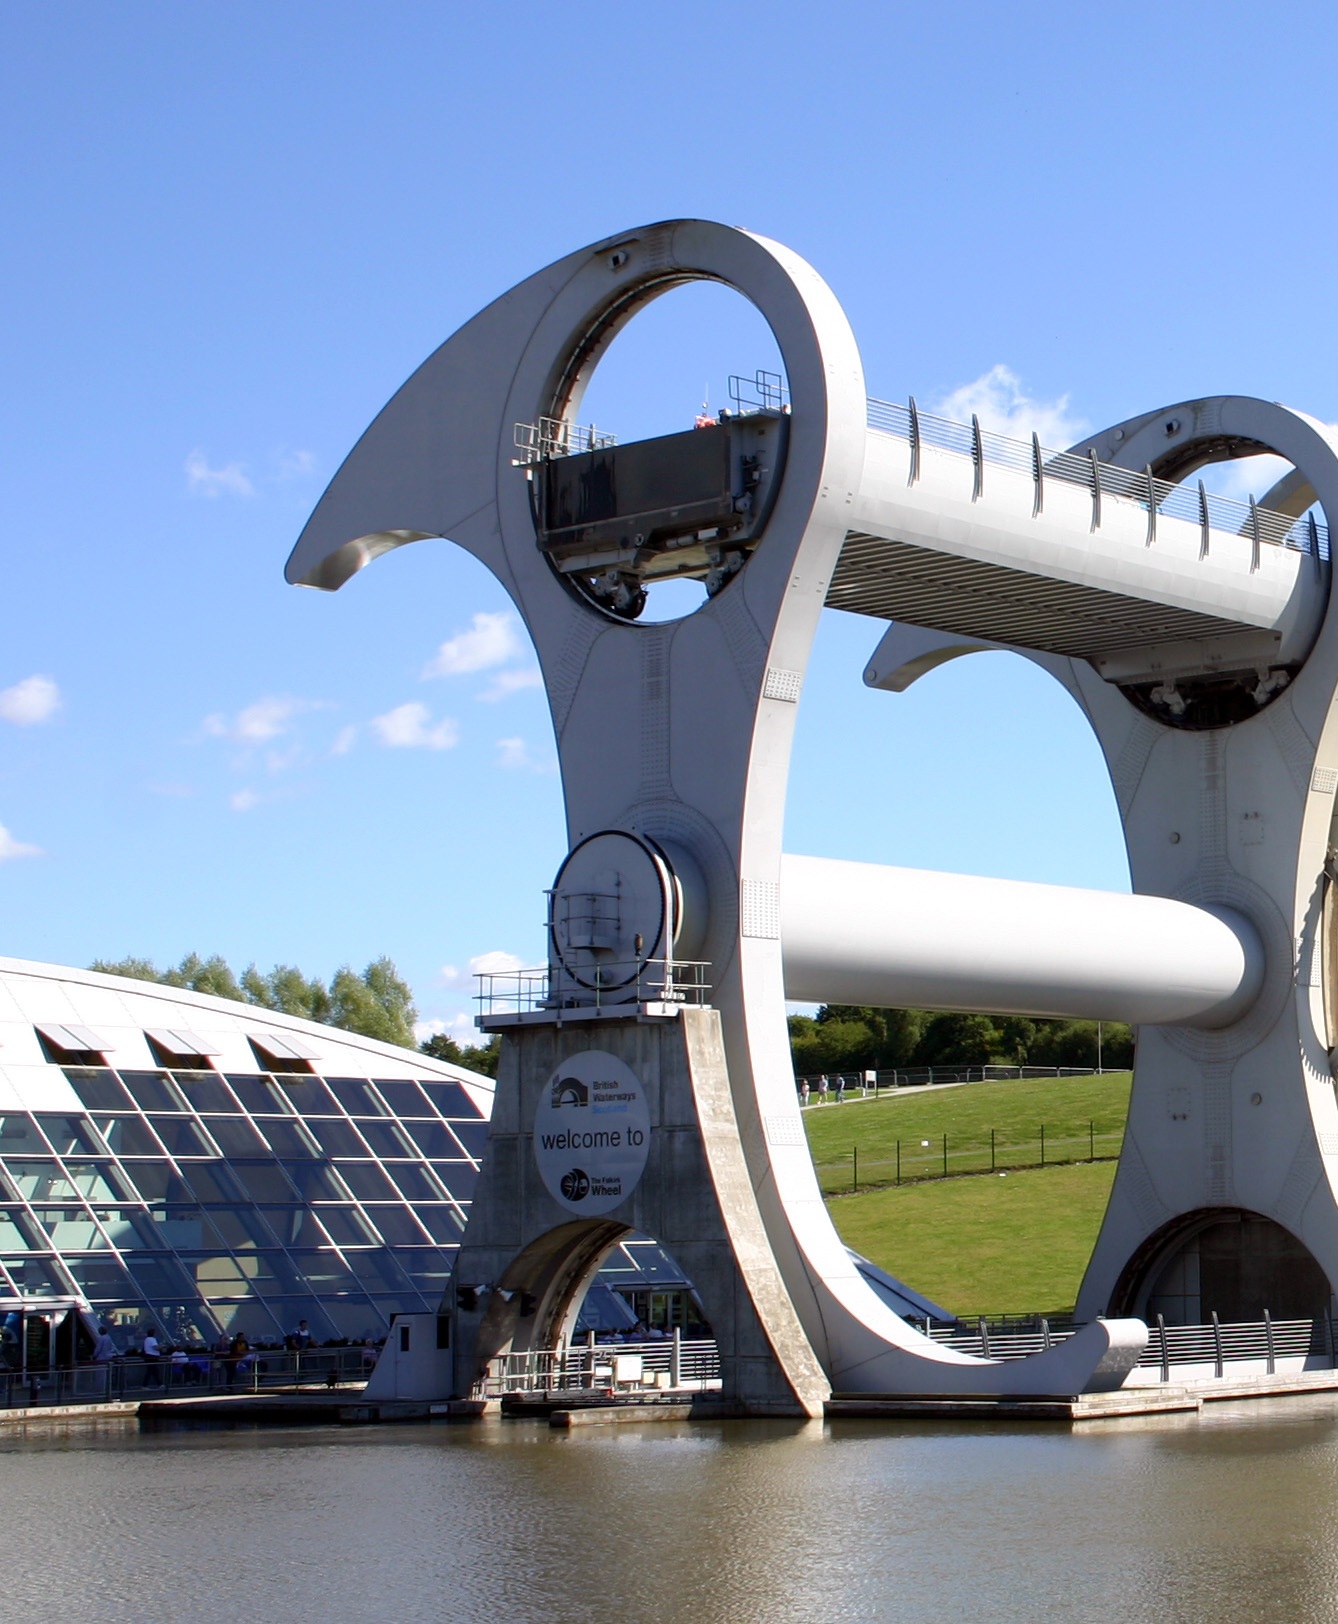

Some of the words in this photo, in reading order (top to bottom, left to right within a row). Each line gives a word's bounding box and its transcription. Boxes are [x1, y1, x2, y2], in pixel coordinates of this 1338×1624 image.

[592, 1081, 619, 1090] British
[592, 1092, 637, 1102] Waterways
[541, 1129, 620, 1150] welcome
[627, 1126, 644, 1146] to
[591, 1184, 622, 1196] Wheel
